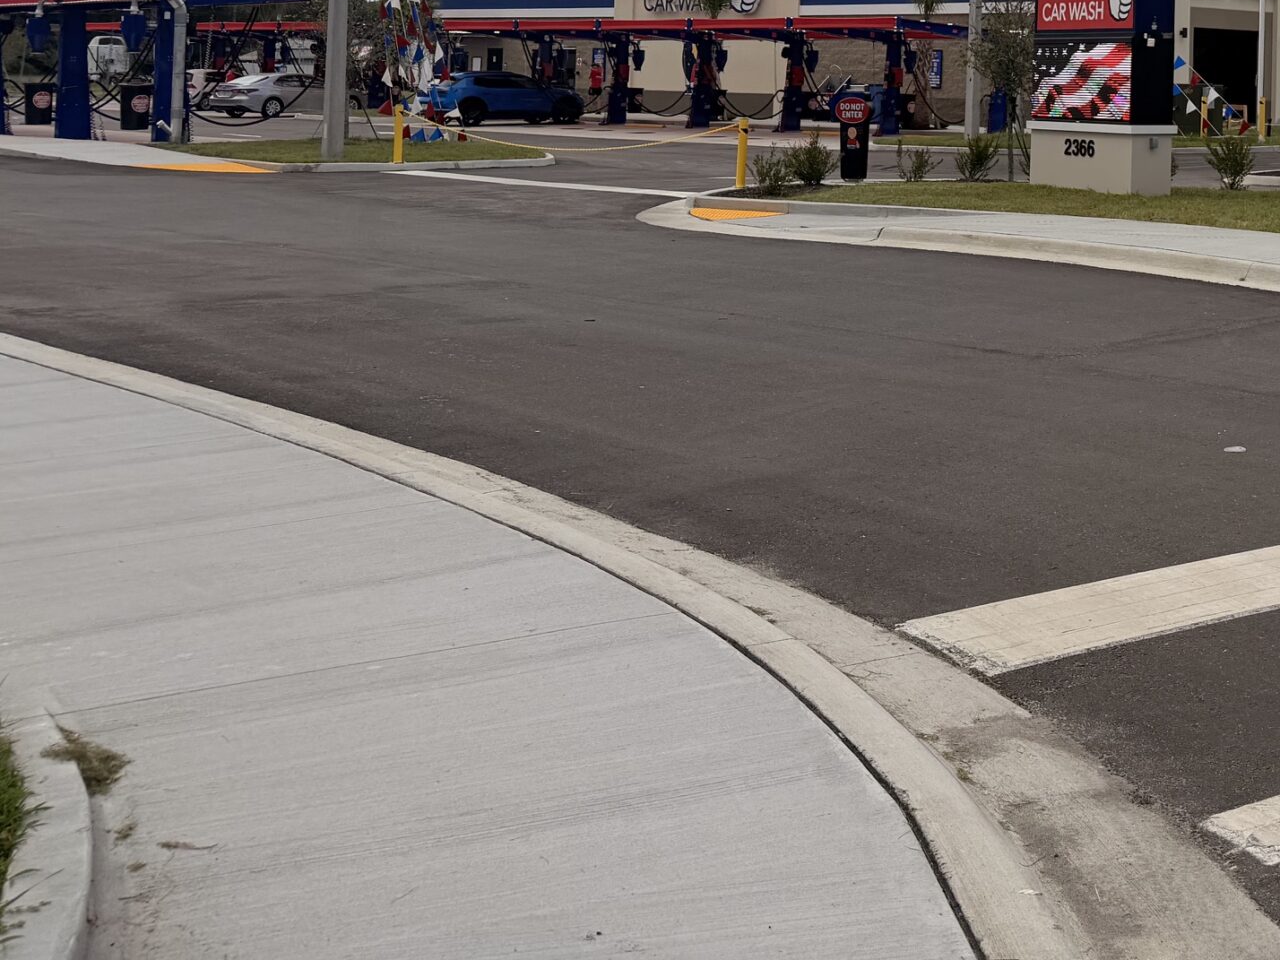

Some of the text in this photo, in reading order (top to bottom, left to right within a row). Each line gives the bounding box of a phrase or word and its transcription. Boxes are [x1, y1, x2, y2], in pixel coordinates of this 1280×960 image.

[1042, 1, 1104, 21] CAR WASH
[1064, 138, 1095, 158] 2366
